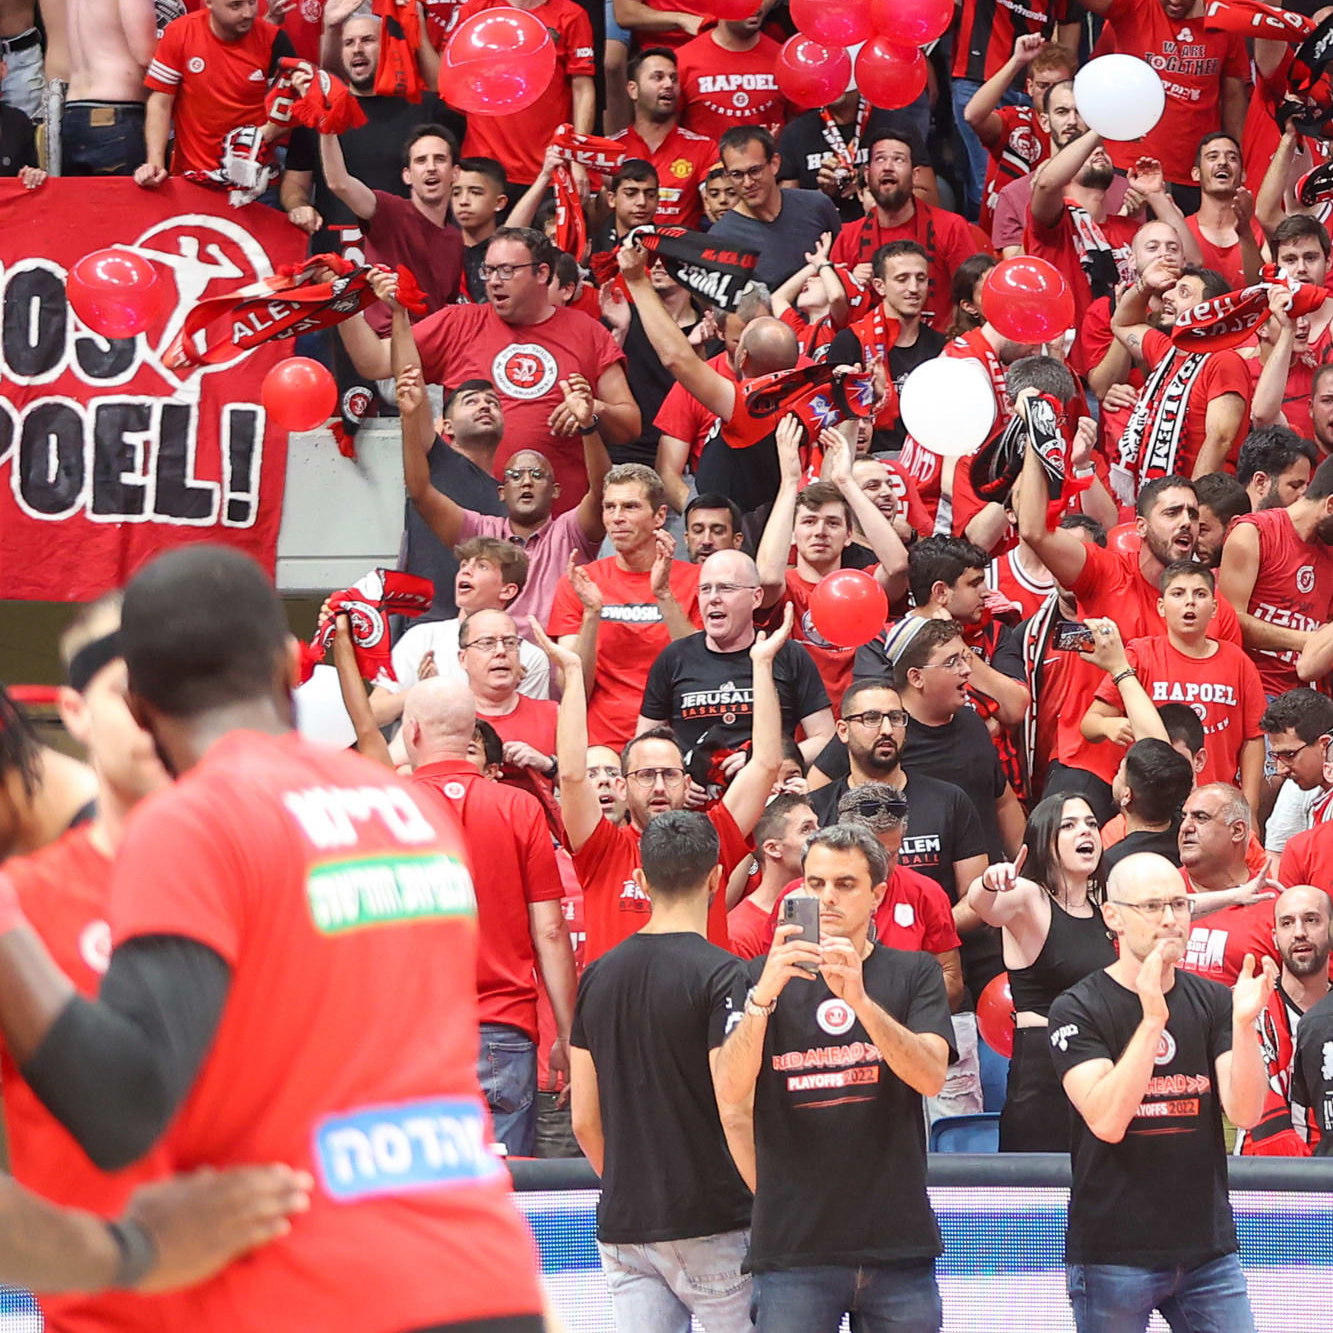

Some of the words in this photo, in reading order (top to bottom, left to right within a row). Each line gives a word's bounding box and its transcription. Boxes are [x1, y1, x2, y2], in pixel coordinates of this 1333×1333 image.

[699, 74, 779, 93] HAPOEL
[0, 396, 266, 529] OEL!
[682, 691, 754, 709] JERUSAL
[1152, 682, 1238, 706] HAPOEL
[787, 1073, 844, 1091] PLAYOFFS
[844, 1068, 877, 1086] 2022
[1169, 1099, 1196, 1116] 2022
